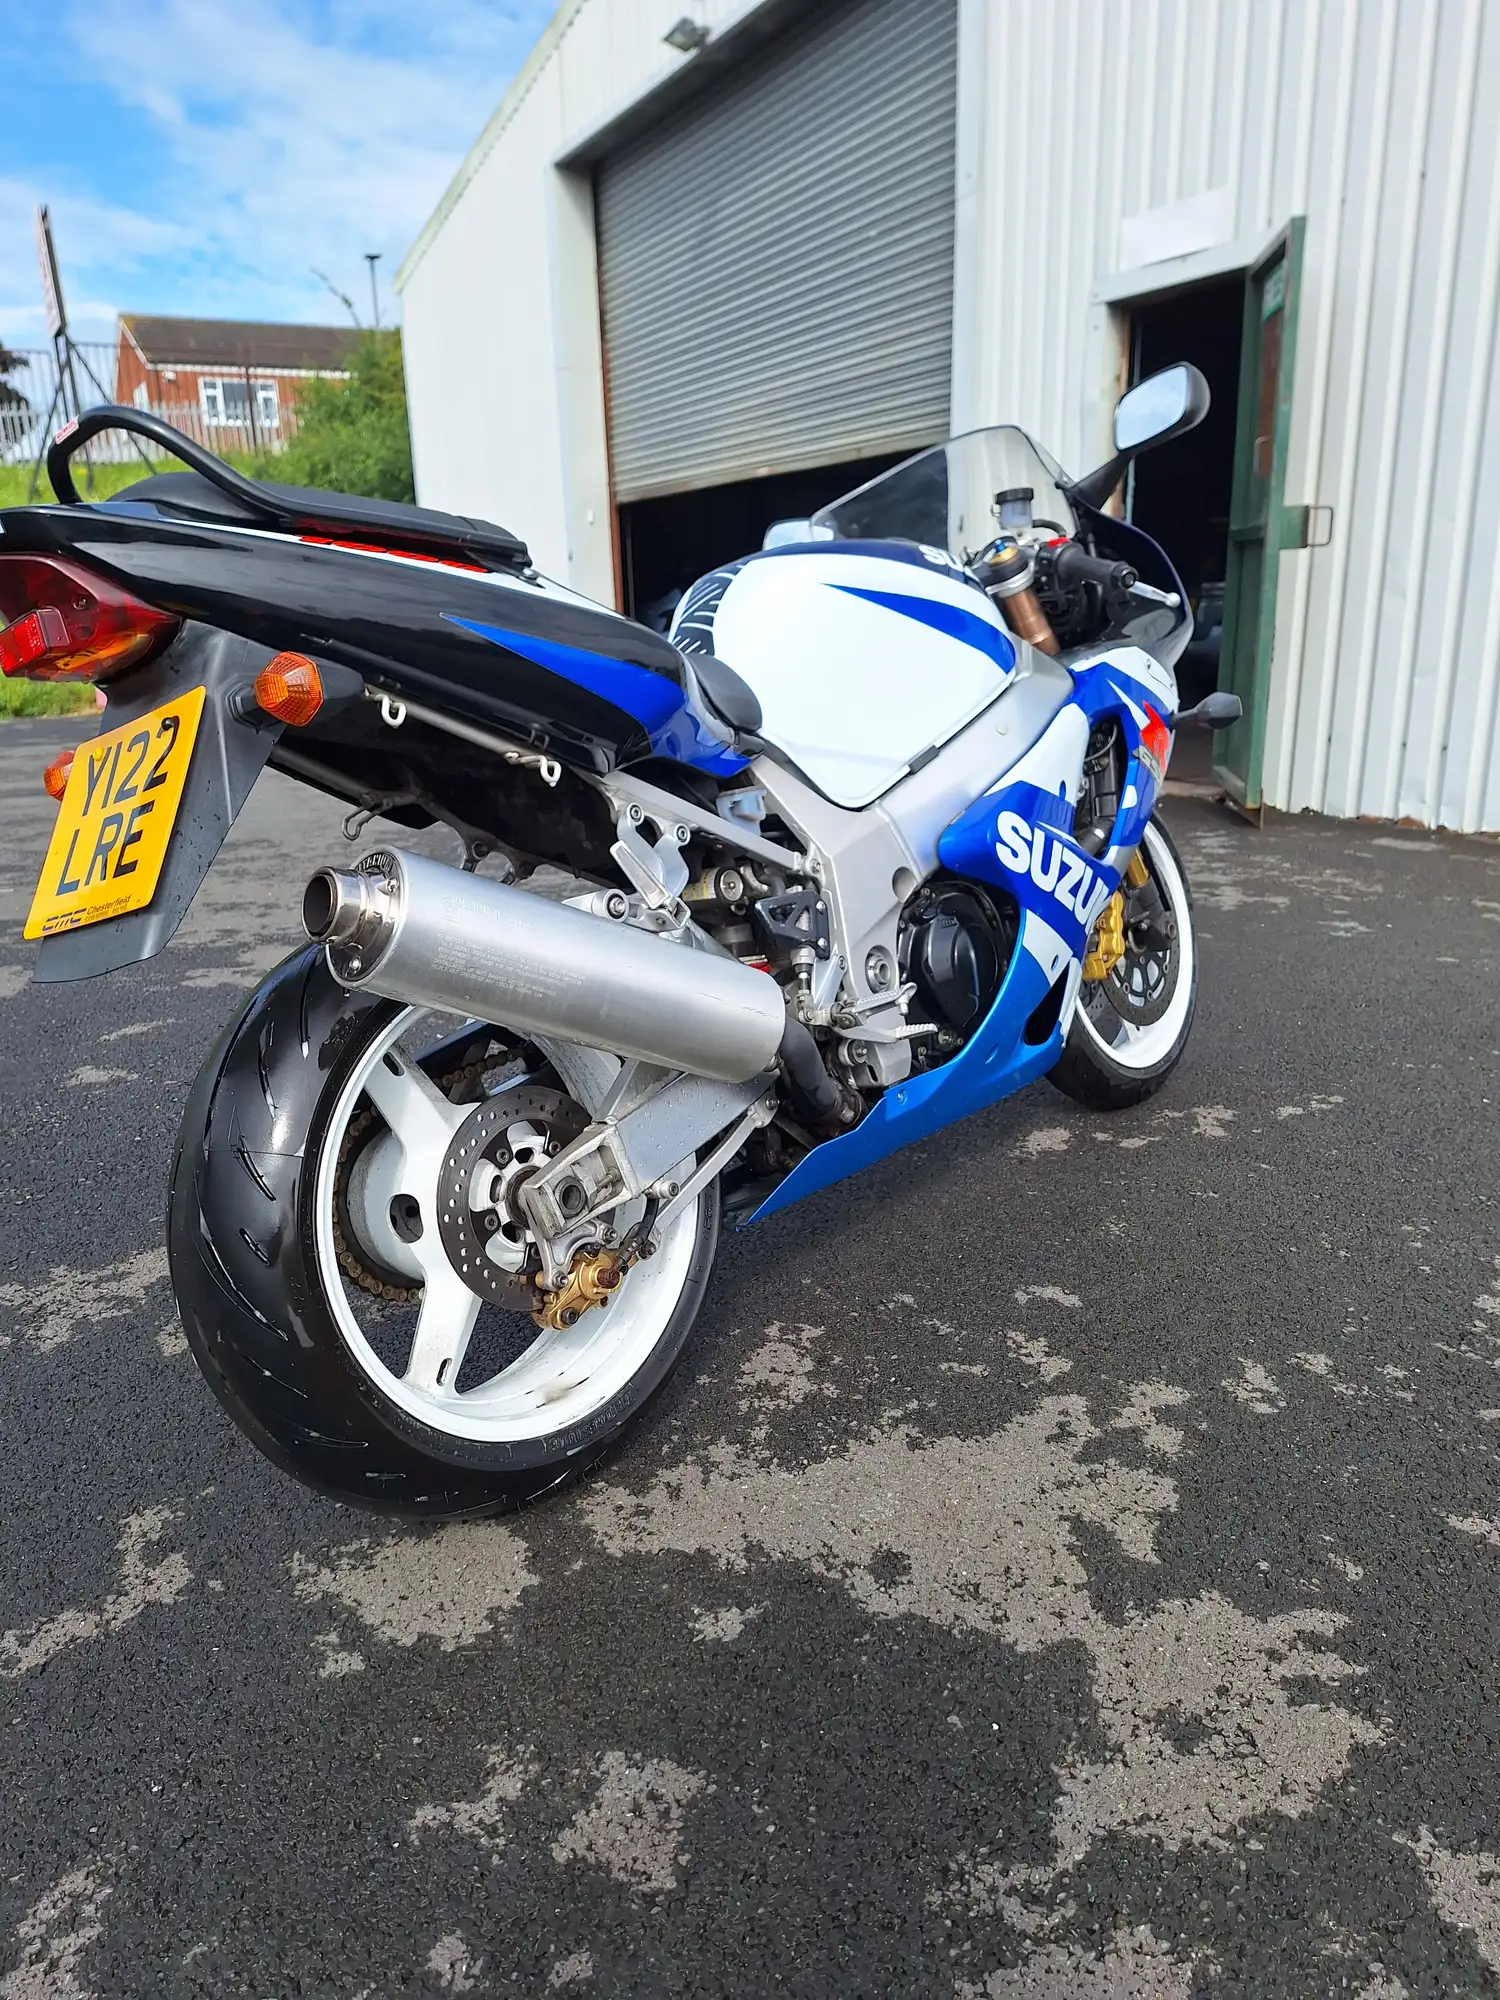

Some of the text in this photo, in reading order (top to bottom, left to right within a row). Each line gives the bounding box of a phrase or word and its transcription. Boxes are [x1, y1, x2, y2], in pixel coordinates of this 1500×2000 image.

[82, 716, 180, 816] Y122
[56, 800, 154, 897] LRE
[86, 893, 132, 915] Chesterfield
